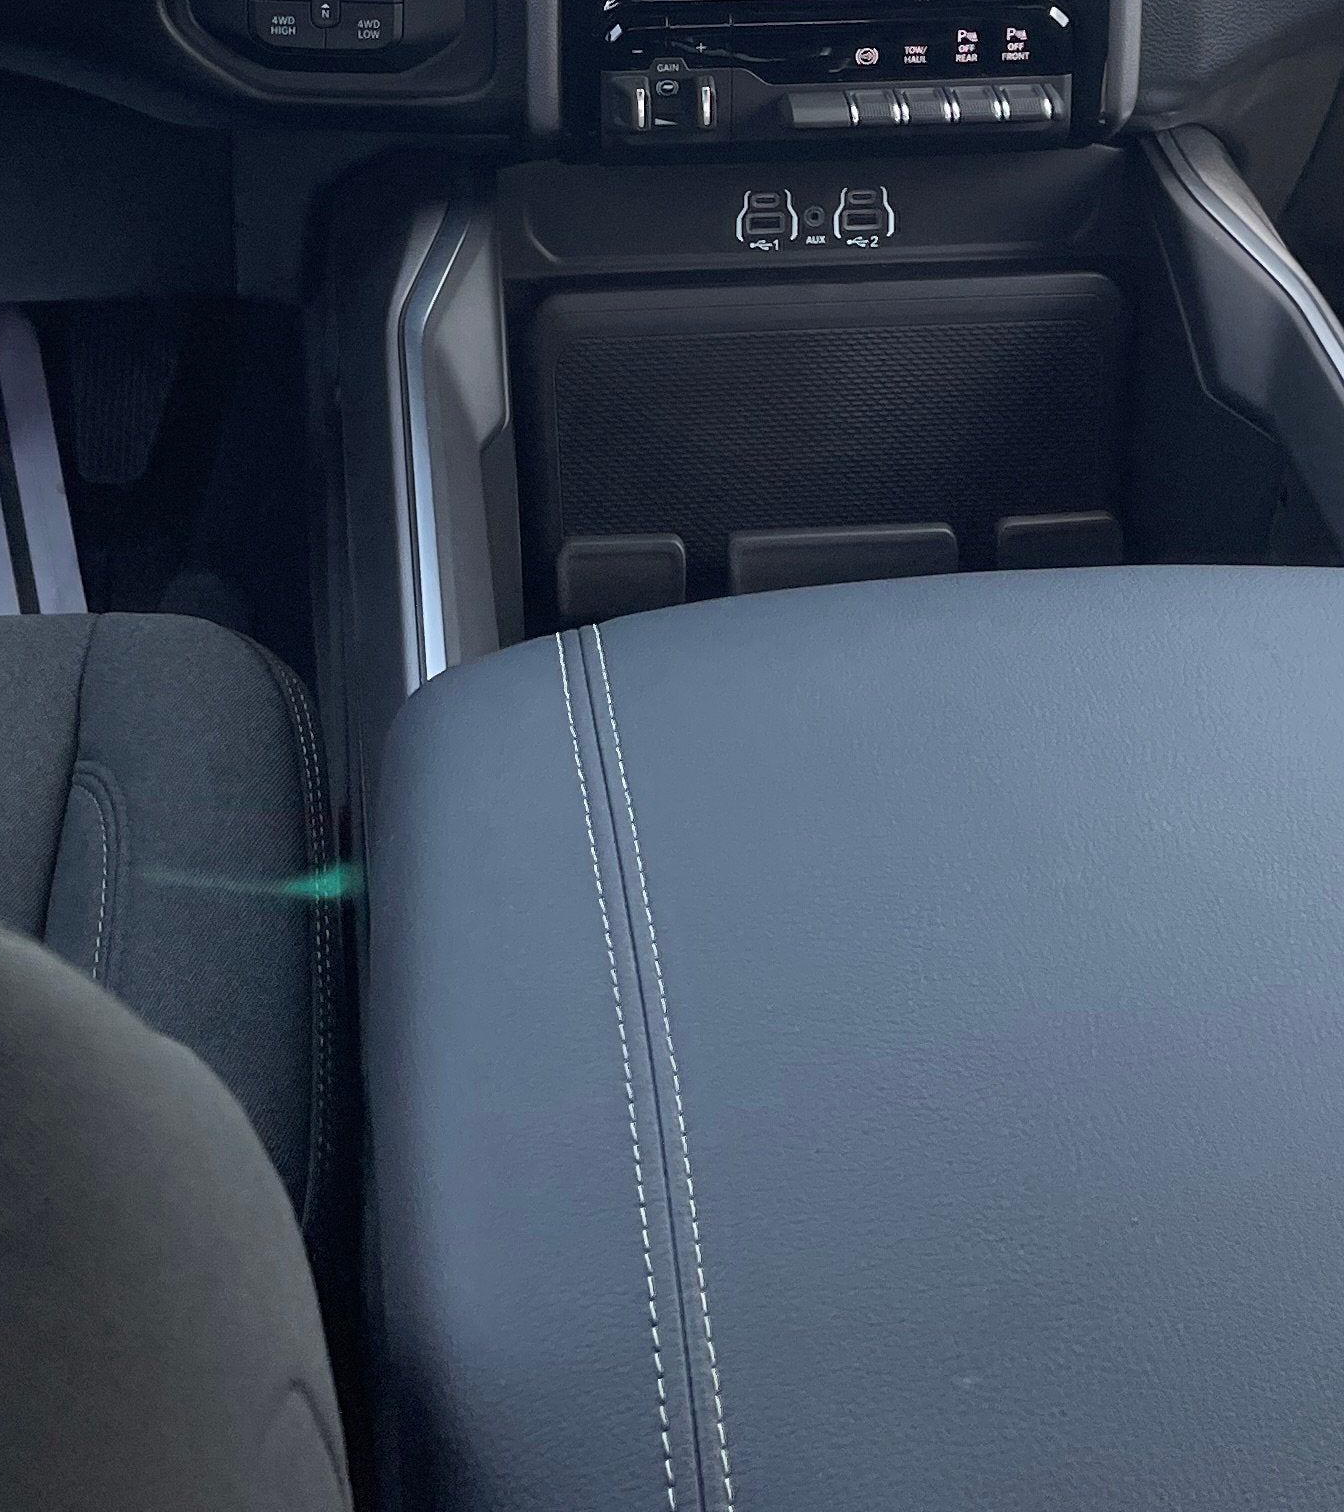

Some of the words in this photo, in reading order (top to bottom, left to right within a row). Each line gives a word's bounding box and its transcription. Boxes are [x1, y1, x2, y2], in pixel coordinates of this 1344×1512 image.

[321, 9, 330, 19] N
[271, 16, 296, 26] 4WD
[357, 19, 381, 29] 4WD
[270, 26, 296, 36] HIGH
[357, 29, 381, 40] LOW
[904, 46, 927, 56] TOW/
[958, 43, 976, 53] OFF
[1007, 42, 1024, 51] OFF
[903, 55, 927, 64] HAUL
[956, 53, 978, 63] REAR
[1001, 51, 1030, 62] FRONT
[656, 63, 680, 73] GAIN
[772, 240, 779, 251] 1
[806, 236, 826, 245] AUX
[870, 236, 879, 248] 2
